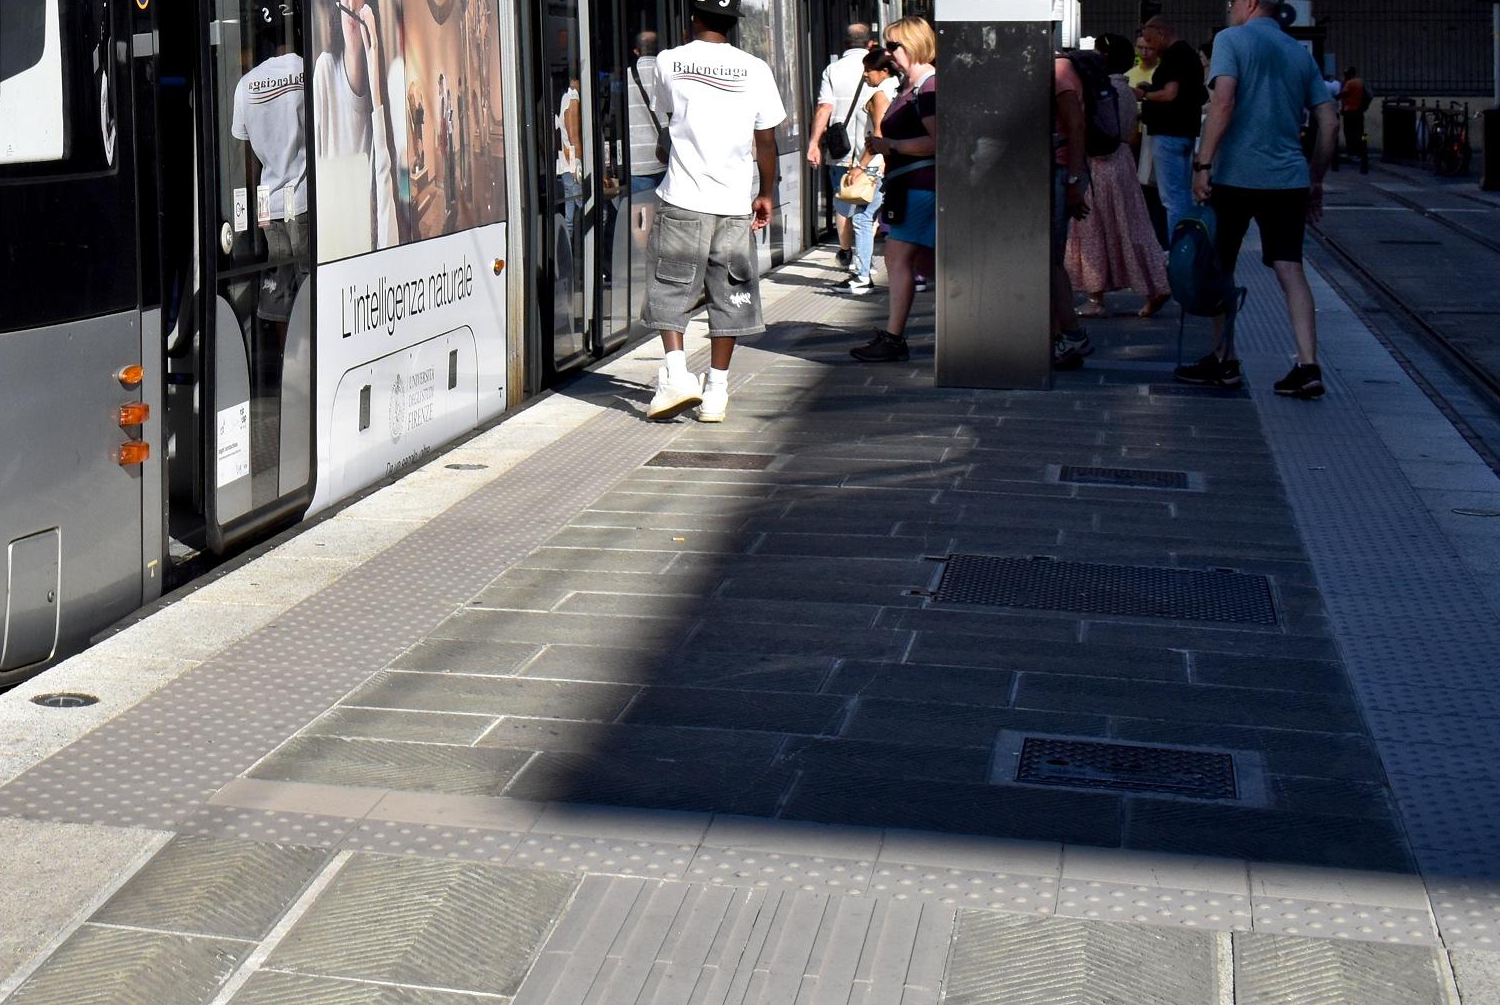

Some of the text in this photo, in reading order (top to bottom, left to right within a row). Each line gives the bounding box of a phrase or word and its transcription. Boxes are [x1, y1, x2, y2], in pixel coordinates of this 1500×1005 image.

[673, 61, 748, 79] Balenciaga
[341, 254, 473, 338] L'intelligenza naturale
[407, 403, 433, 430] FIRENZE
